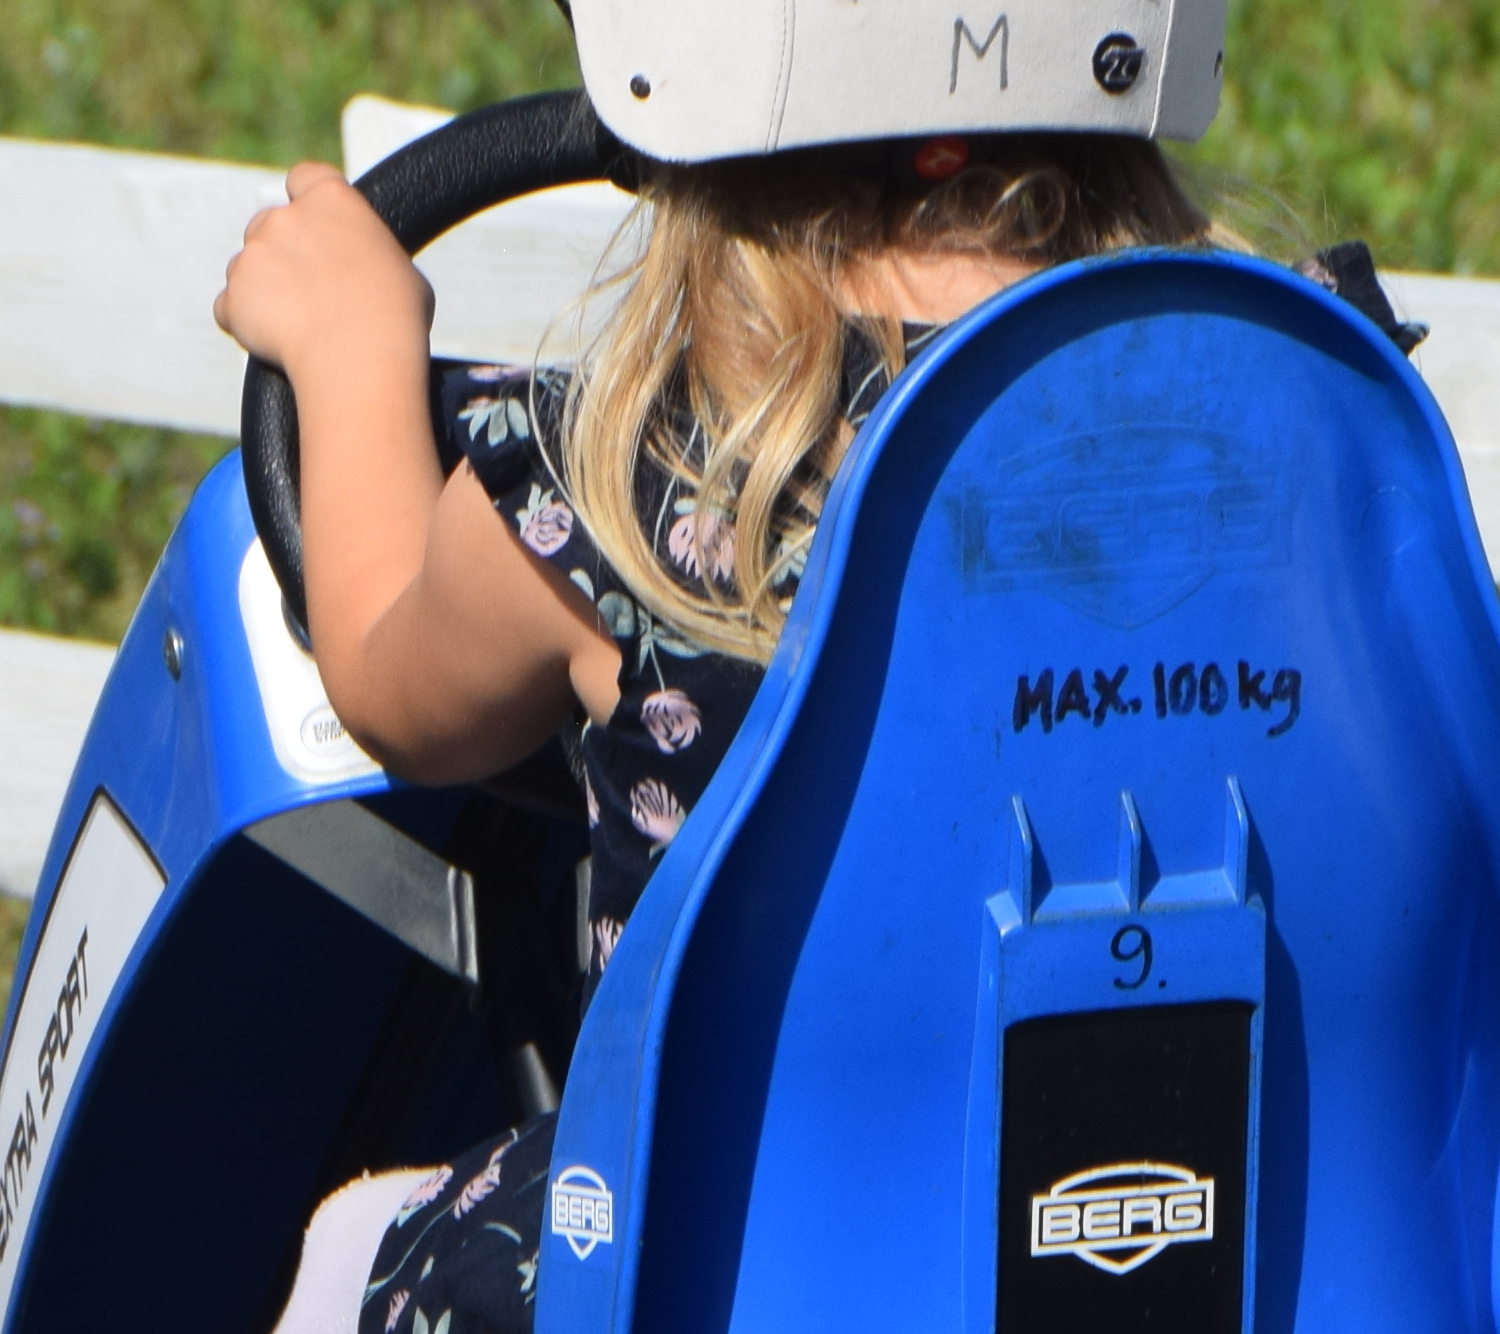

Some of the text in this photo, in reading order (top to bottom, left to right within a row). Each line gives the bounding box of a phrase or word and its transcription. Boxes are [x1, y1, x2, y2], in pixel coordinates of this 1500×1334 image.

[949, 12, 1009, 95] M
[37, 923, 89, 1121] SPORT
[555, 1192, 609, 1235] BERG
[1042, 1191, 1203, 1245] BERG
